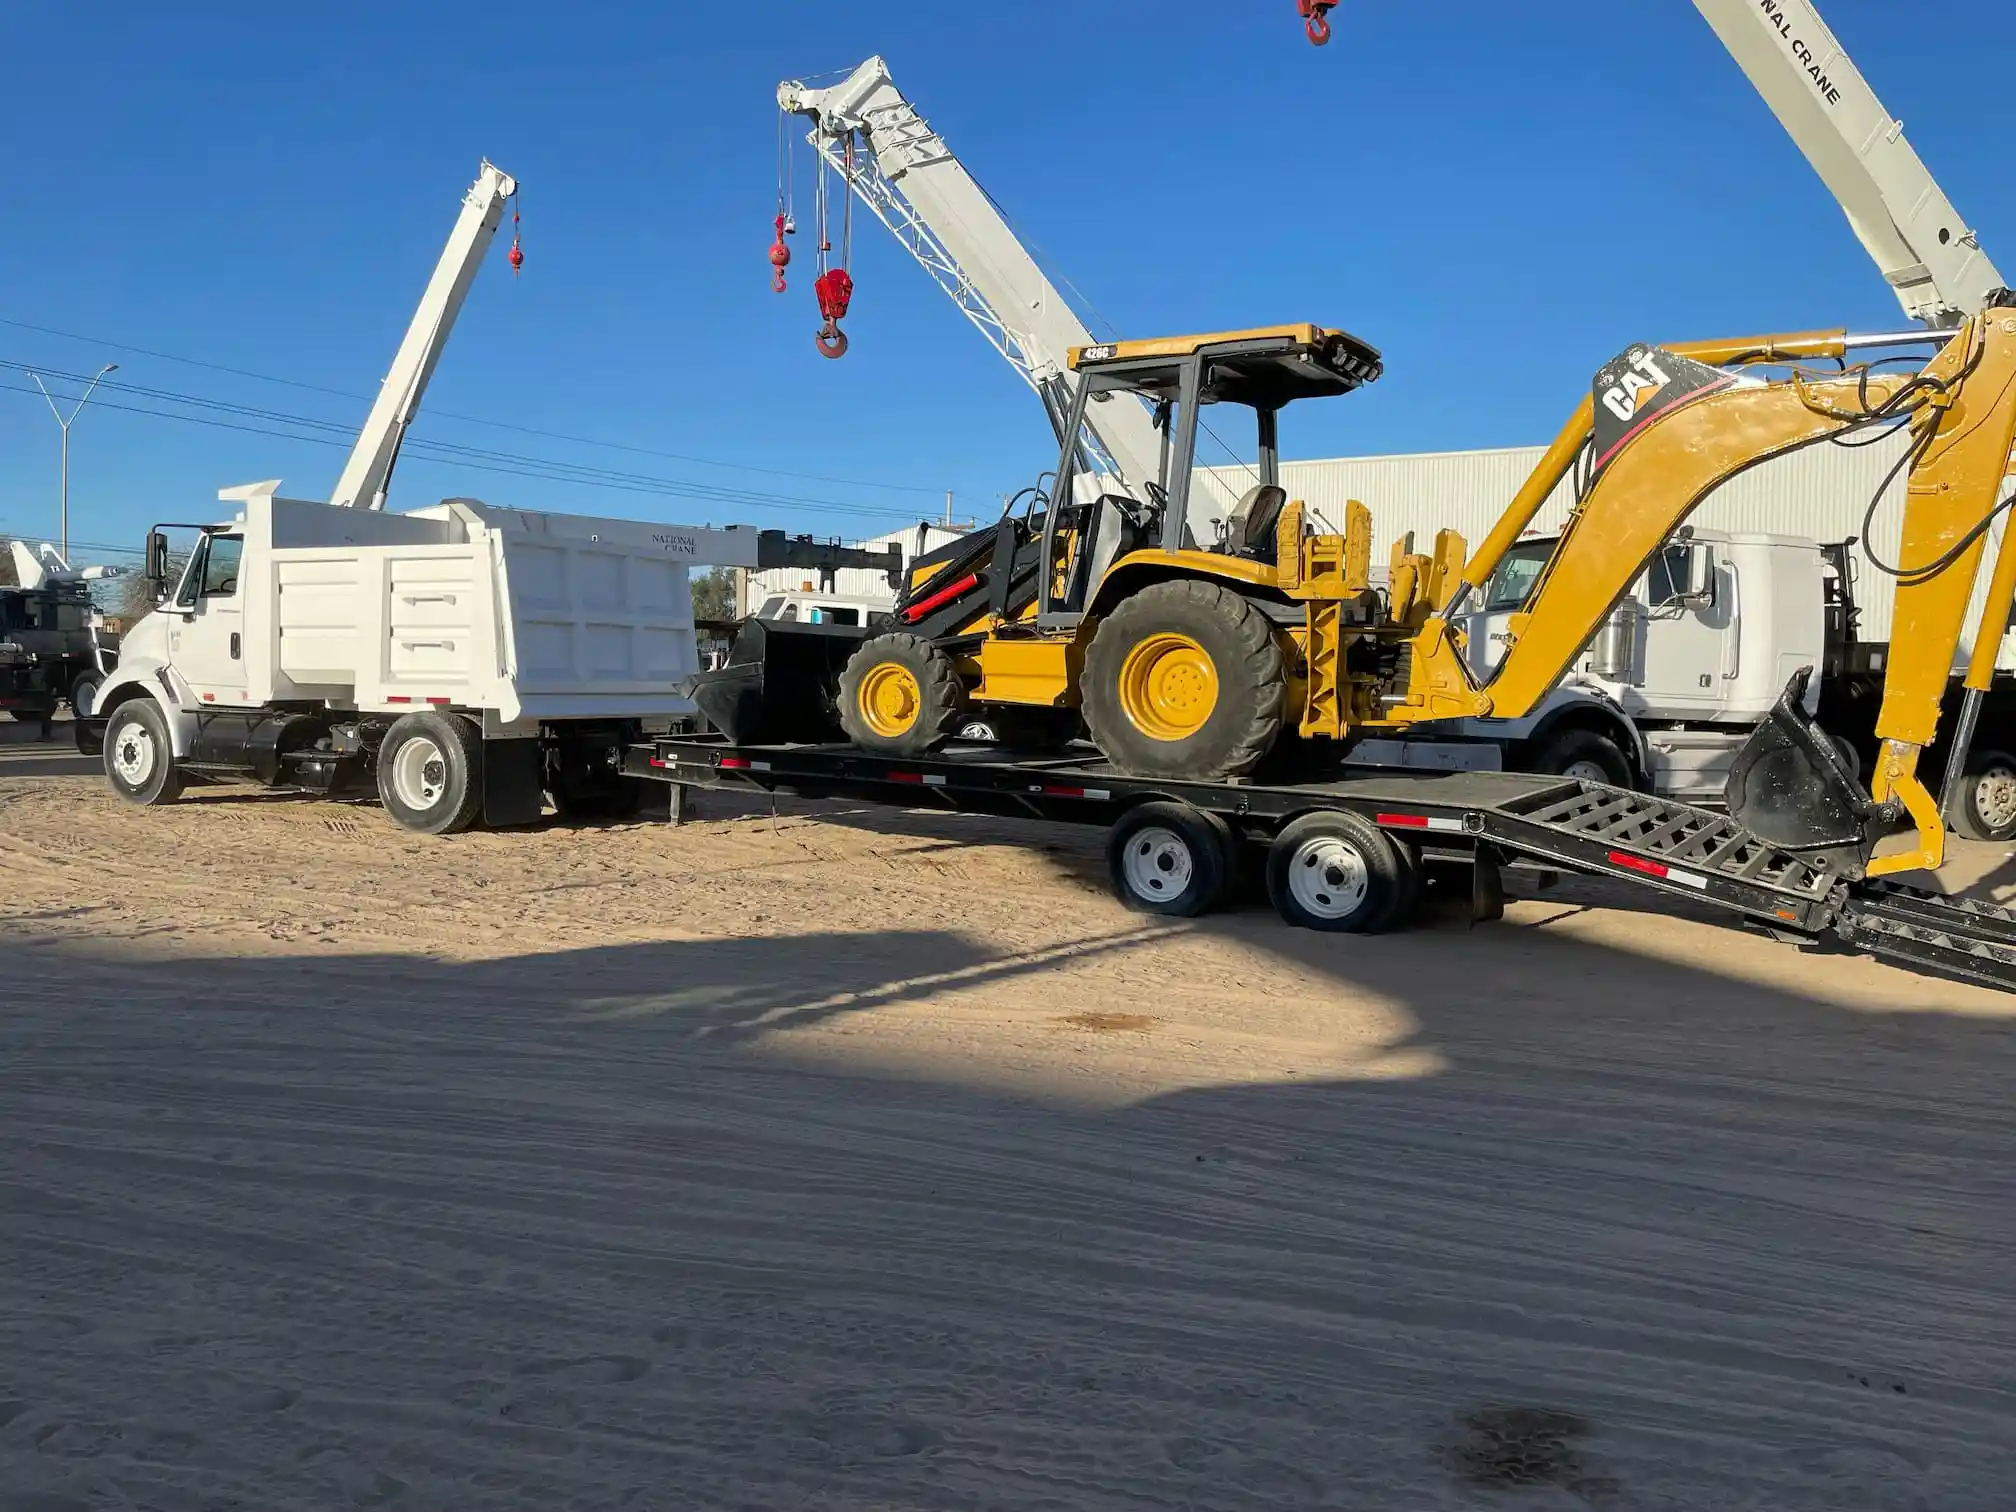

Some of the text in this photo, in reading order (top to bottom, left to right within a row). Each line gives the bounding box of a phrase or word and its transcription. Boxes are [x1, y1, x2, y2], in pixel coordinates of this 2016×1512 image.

[1792, 39, 1840, 106] CRANE
[1085, 346, 1109, 359] 426C
[1602, 351, 1671, 421] CAT
[652, 533, 696, 546] NATIONAL
